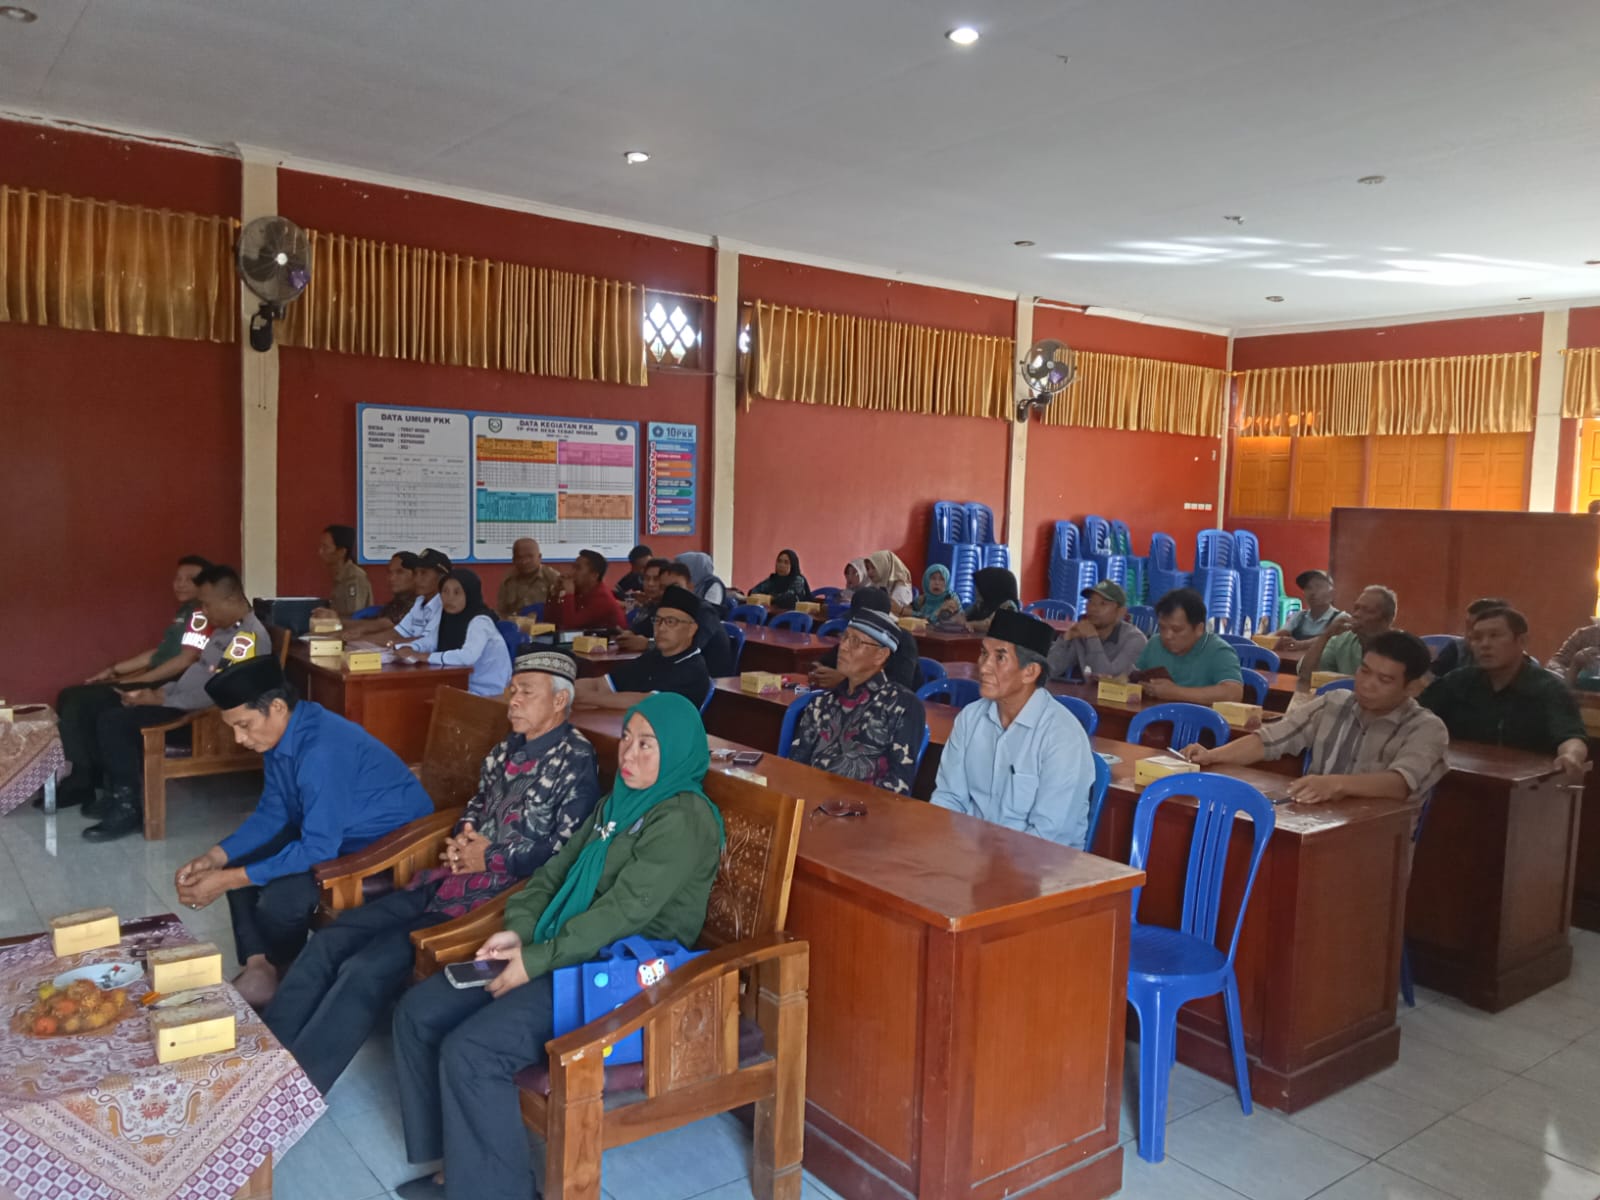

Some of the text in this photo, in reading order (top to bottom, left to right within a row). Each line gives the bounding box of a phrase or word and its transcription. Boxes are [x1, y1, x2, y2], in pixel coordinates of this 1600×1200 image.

[381, 414, 403, 422] DATA
[405, 415, 431, 423] UMUM
[541, 421, 577, 429] KEGIATAN
[666, 427, 693, 438] 10 PKK
